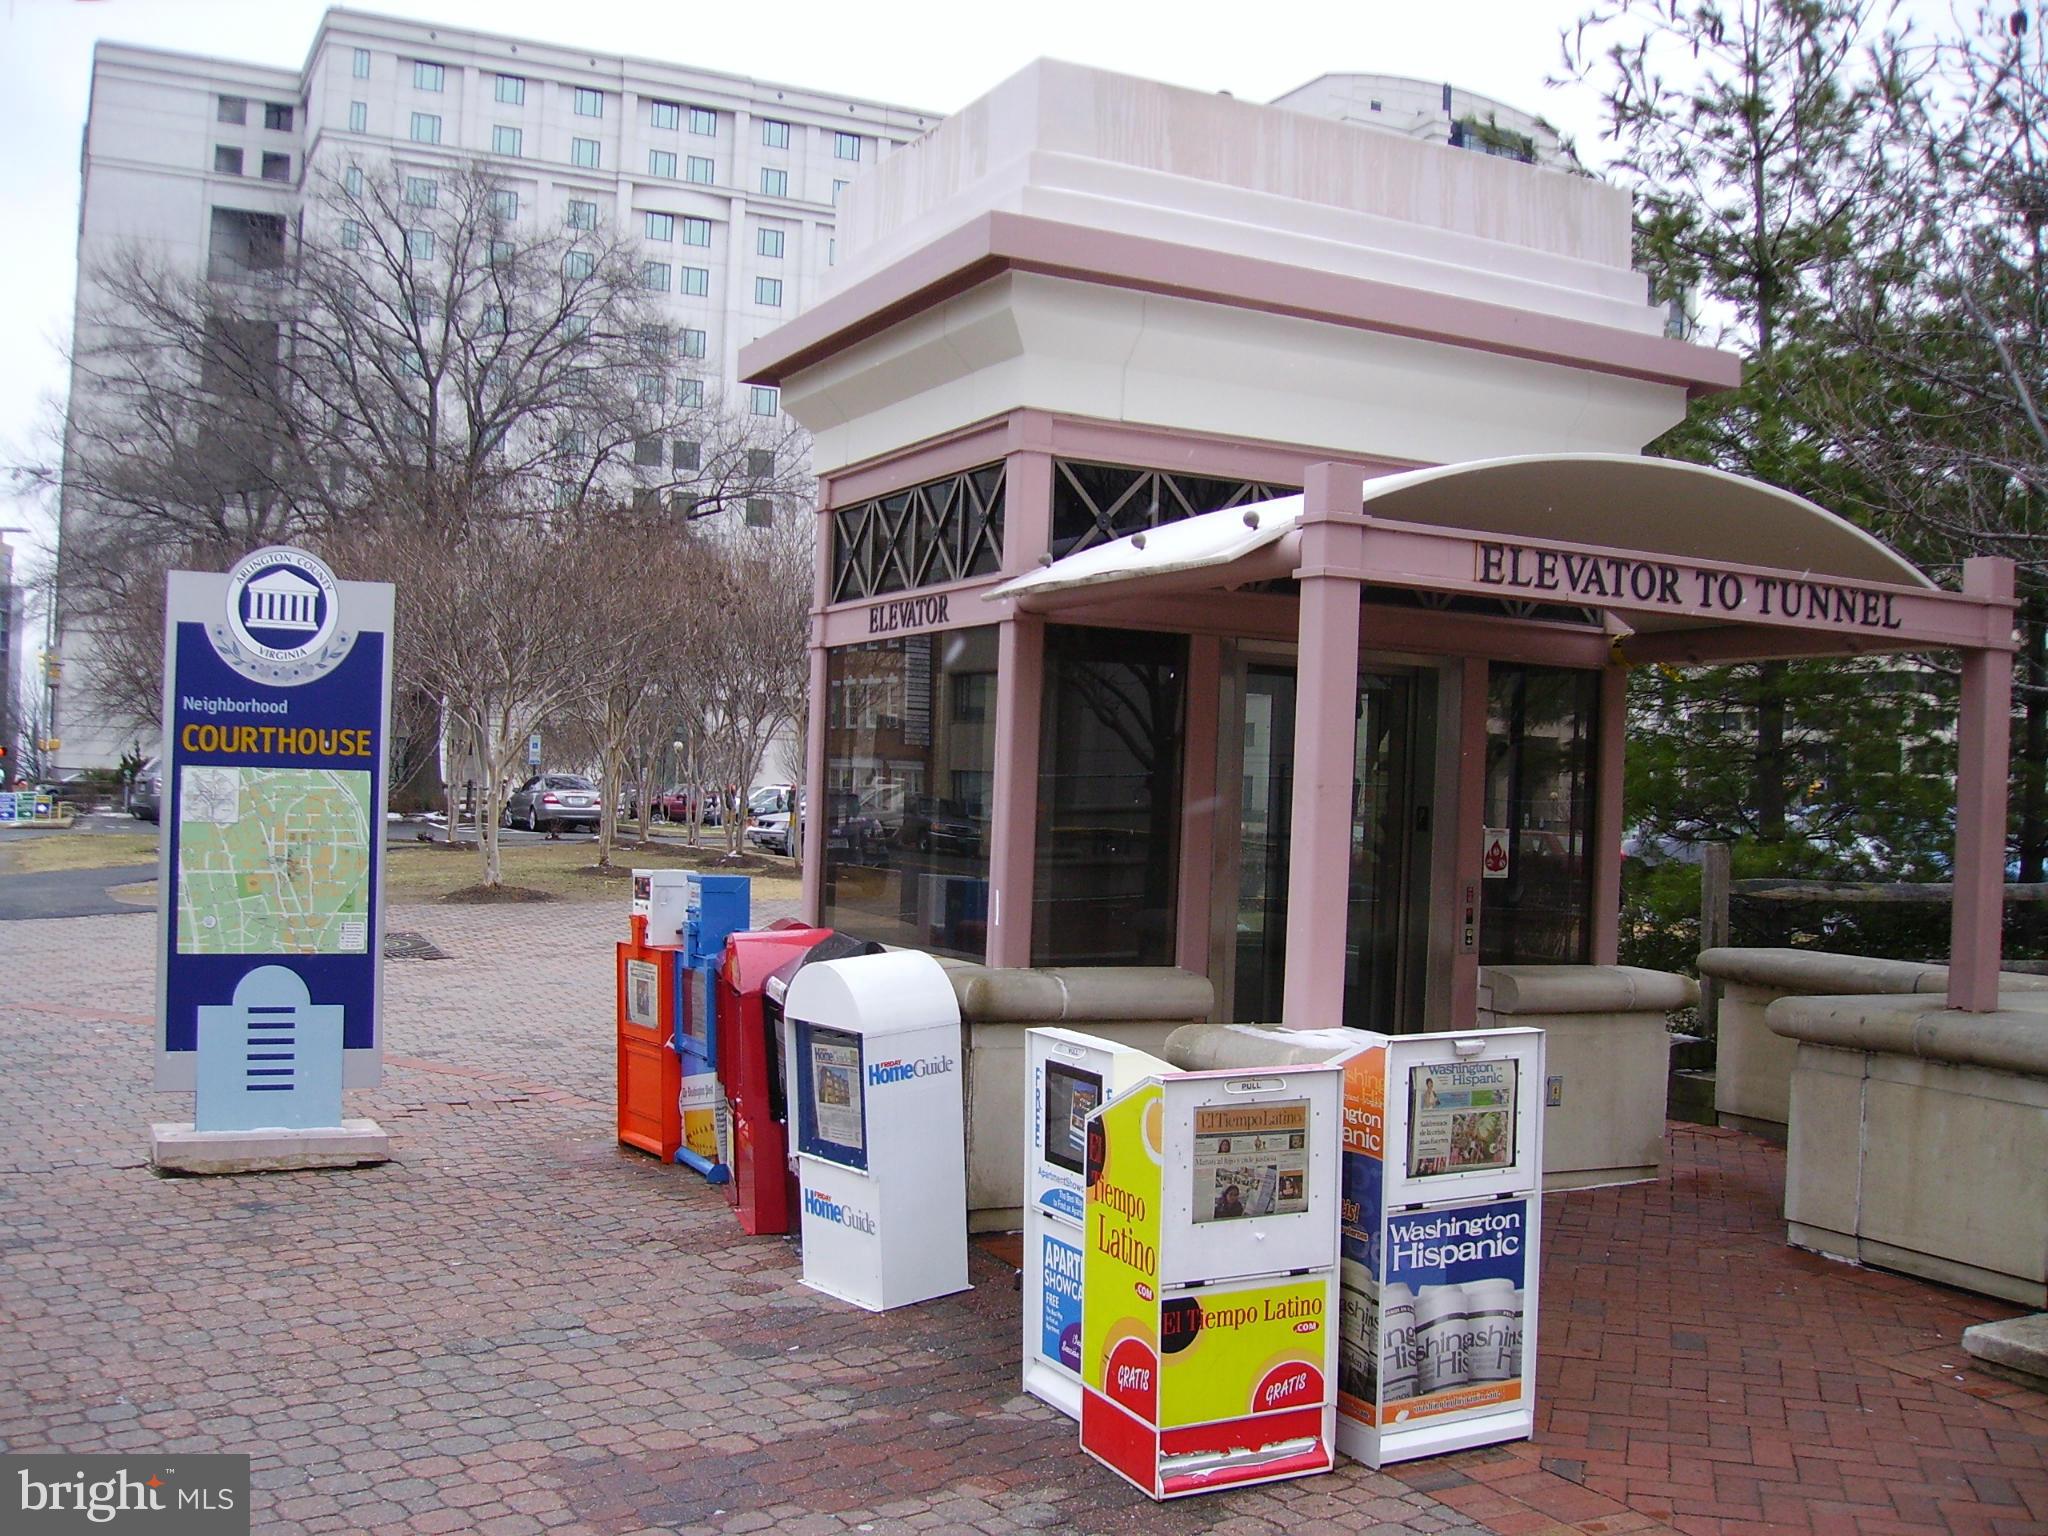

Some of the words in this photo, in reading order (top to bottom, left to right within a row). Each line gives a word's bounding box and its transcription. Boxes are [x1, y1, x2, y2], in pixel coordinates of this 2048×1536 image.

[236, 553, 291, 585] ARLINGTON
[297, 557, 333, 592] COUNTY
[1480, 544, 1682, 604] ELEVATOR
[1695, 570, 1744, 611] TO
[1755, 577, 1902, 630] TUNNEL
[869, 593, 950, 634] ELEVATOR
[258, 647, 308, 660] VIRGINIA
[183, 696, 288, 714] Neighborhood
[182, 723, 372, 757] COURTHOUSE
[1241, 1082, 1262, 1090] PULL
[1429, 1063, 1494, 1075] Washington
[1452, 1074, 1504, 1086] Hispanic
[1091, 1170, 1145, 1223] Tiempo
[1099, 1213, 1155, 1277] Latino
[1389, 1213, 1520, 1243] Washington
[1392, 1231, 1519, 1271] Hispanic
[1163, 1311, 1181, 1335] El
[1187, 1305, 1258, 1330] Tiempo
[1263, 1296, 1323, 1322] Latino
[1118, 1364, 1150, 1392] GRATIS
[1265, 1372, 1307, 1406] GRATIS
